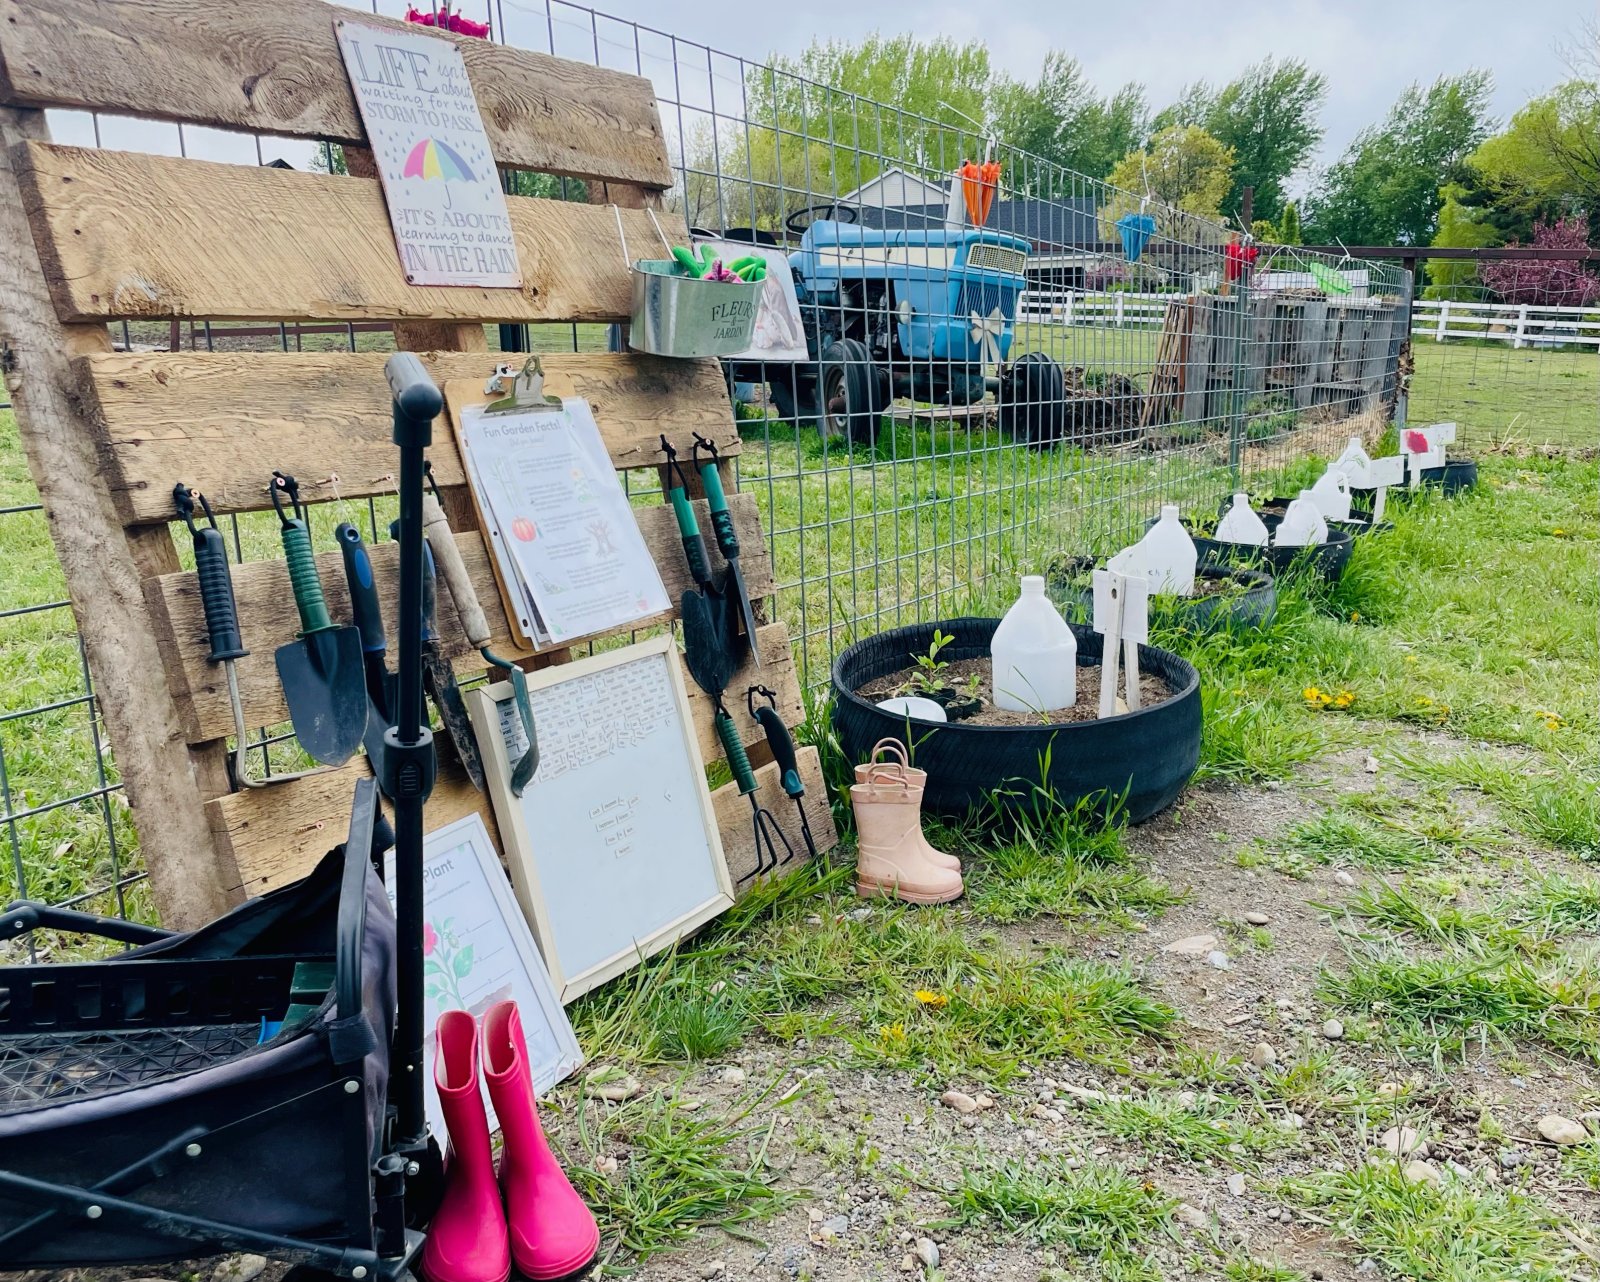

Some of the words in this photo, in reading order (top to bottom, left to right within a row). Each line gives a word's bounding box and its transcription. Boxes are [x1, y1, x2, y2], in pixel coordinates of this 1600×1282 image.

[350, 40, 439, 94] LIFE
[360, 86, 423, 109] waiting
[430, 94, 448, 110] for
[454, 100, 476, 114] the
[441, 77, 473, 100] about
[365, 101, 418, 125] STORM
[418, 109, 440, 127] TO
[402, 208, 437, 226] IT'S
[441, 212, 503, 231] ABOUT
[400, 227, 460, 245] learning
[462, 231, 474, 243] to
[478, 230, 513, 245] dance
[403, 243, 429, 272] IN
[429, 245, 473, 273] THE
[473, 246, 518, 274] RAIN
[711, 301, 755, 321] FLEURS
[713, 327, 743, 339] JARDIN
[482, 426, 501, 438] Fun
[501, 421, 535, 436] Garden
[536, 419, 561, 432] Facts!
[423, 859, 455, 884] Plant
